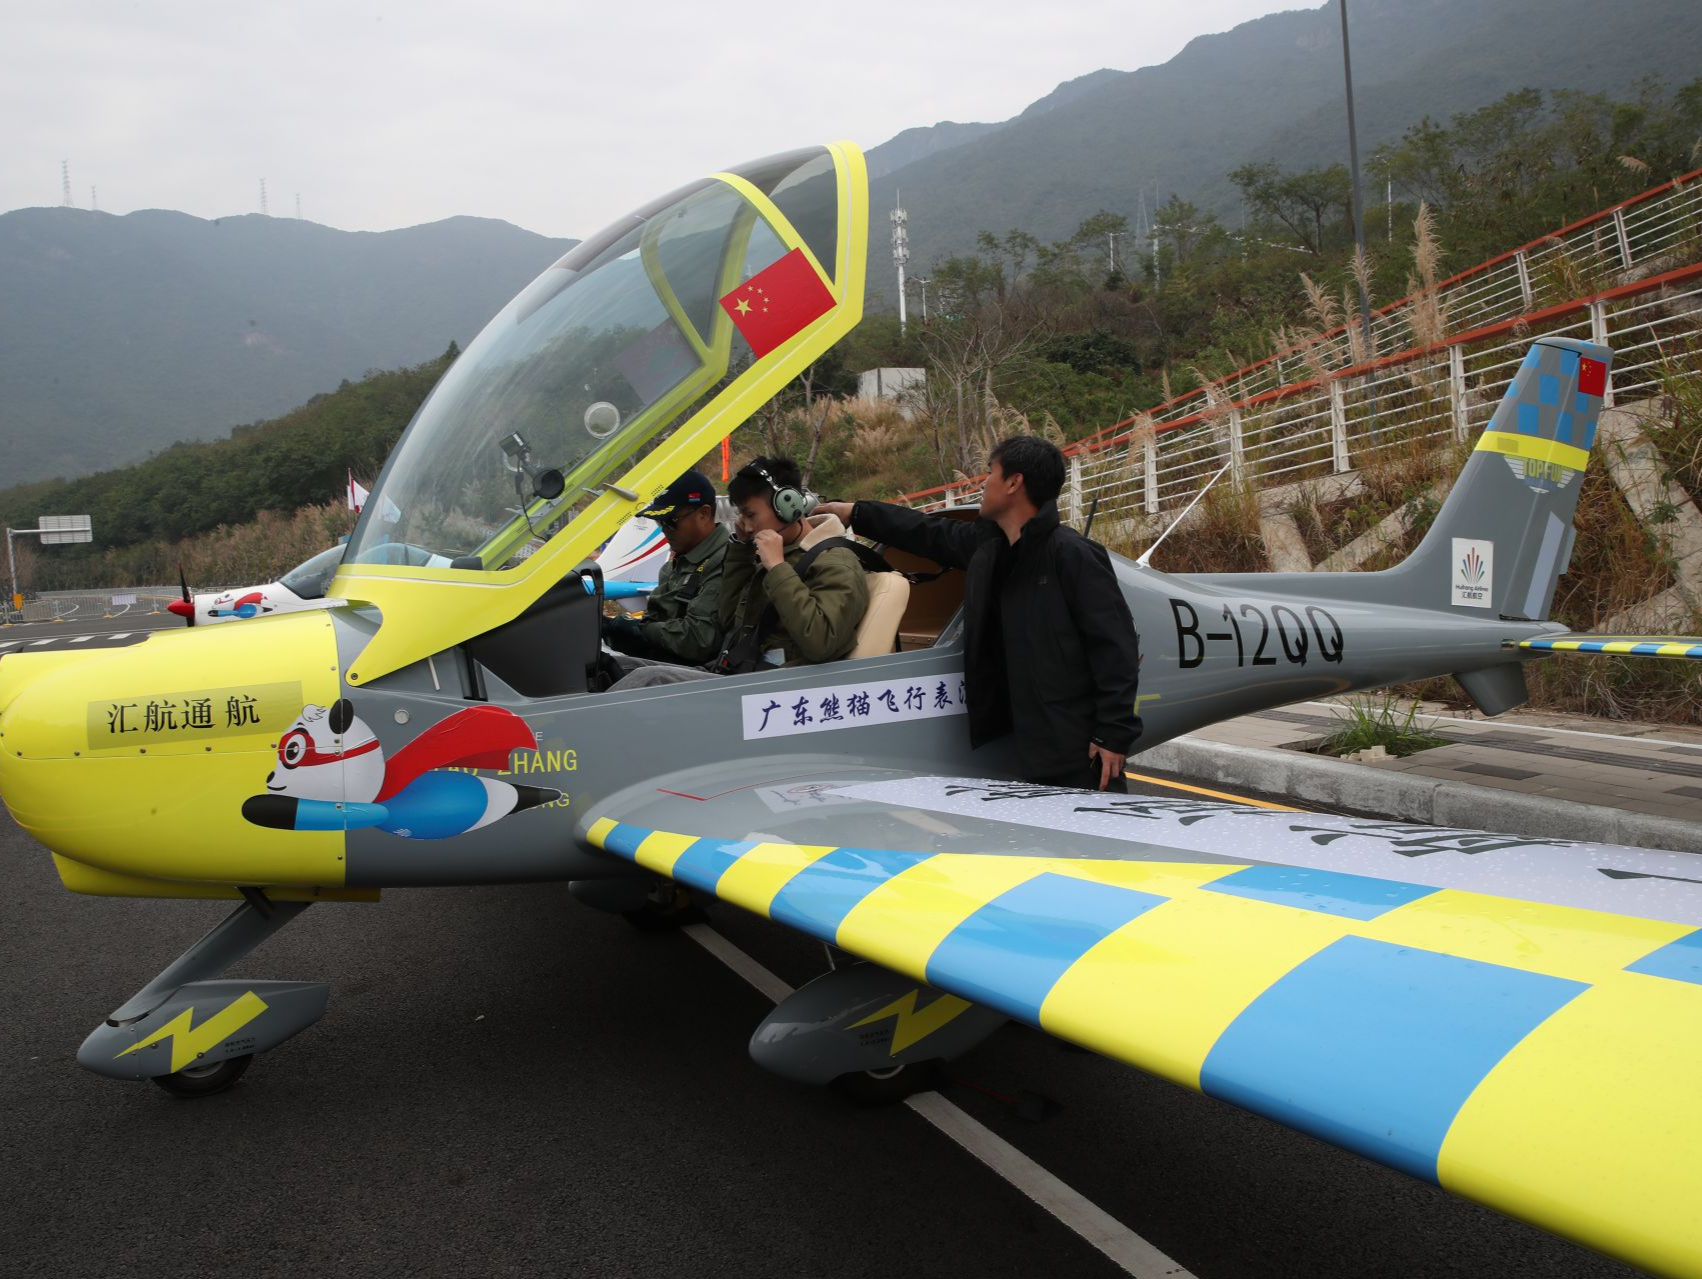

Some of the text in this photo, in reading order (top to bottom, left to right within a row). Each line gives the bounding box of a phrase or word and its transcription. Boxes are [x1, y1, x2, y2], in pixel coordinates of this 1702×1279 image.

[1169, 598, 1344, 669] B-12QQ
[107, 694, 261, 734] 汇航通航
